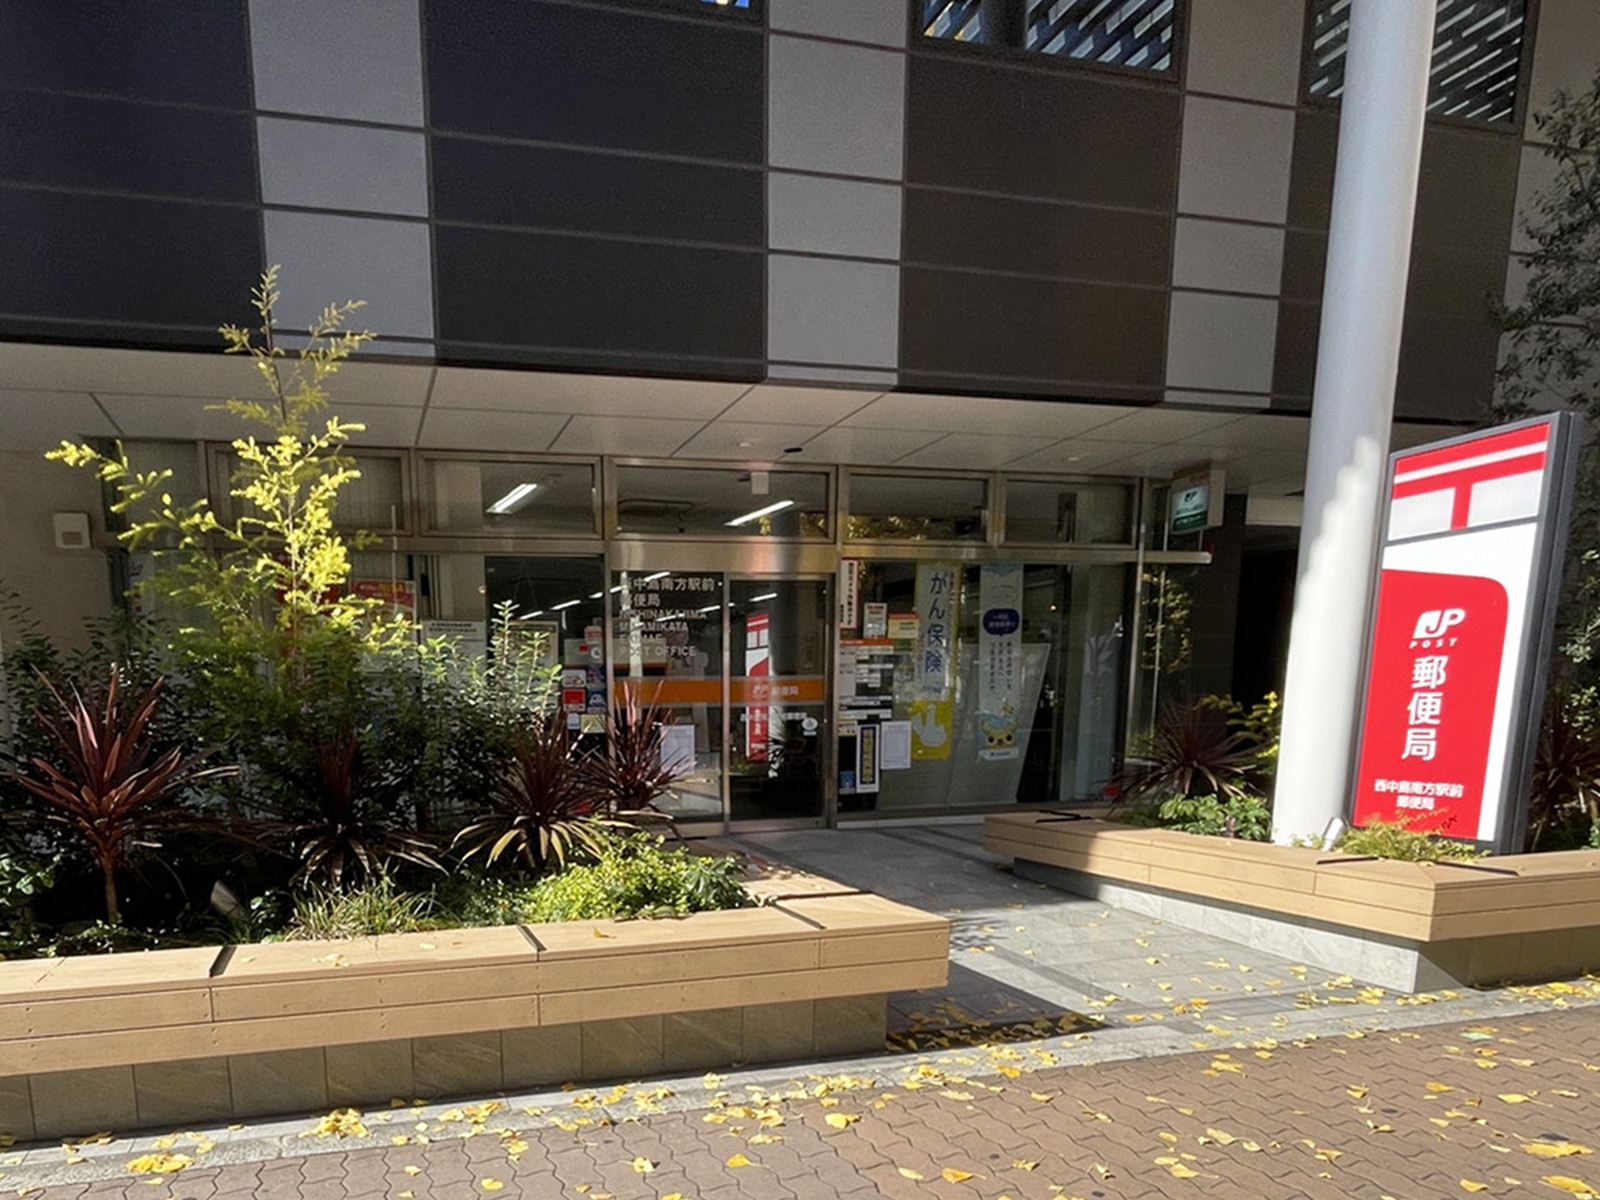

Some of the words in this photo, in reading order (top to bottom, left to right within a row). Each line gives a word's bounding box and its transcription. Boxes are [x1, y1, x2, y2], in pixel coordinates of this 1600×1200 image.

[619, 621, 688, 632] MAMIKATA
[925, 572, 948, 674] がん保険
[655, 646, 696, 656] OFFICE
[1409, 638, 1458, 649] POST
[1401, 655, 1449, 761] 郵便局
[1374, 778, 1464, 798] 西中島南方駅前
[1396, 795, 1435, 811] 郵便局
